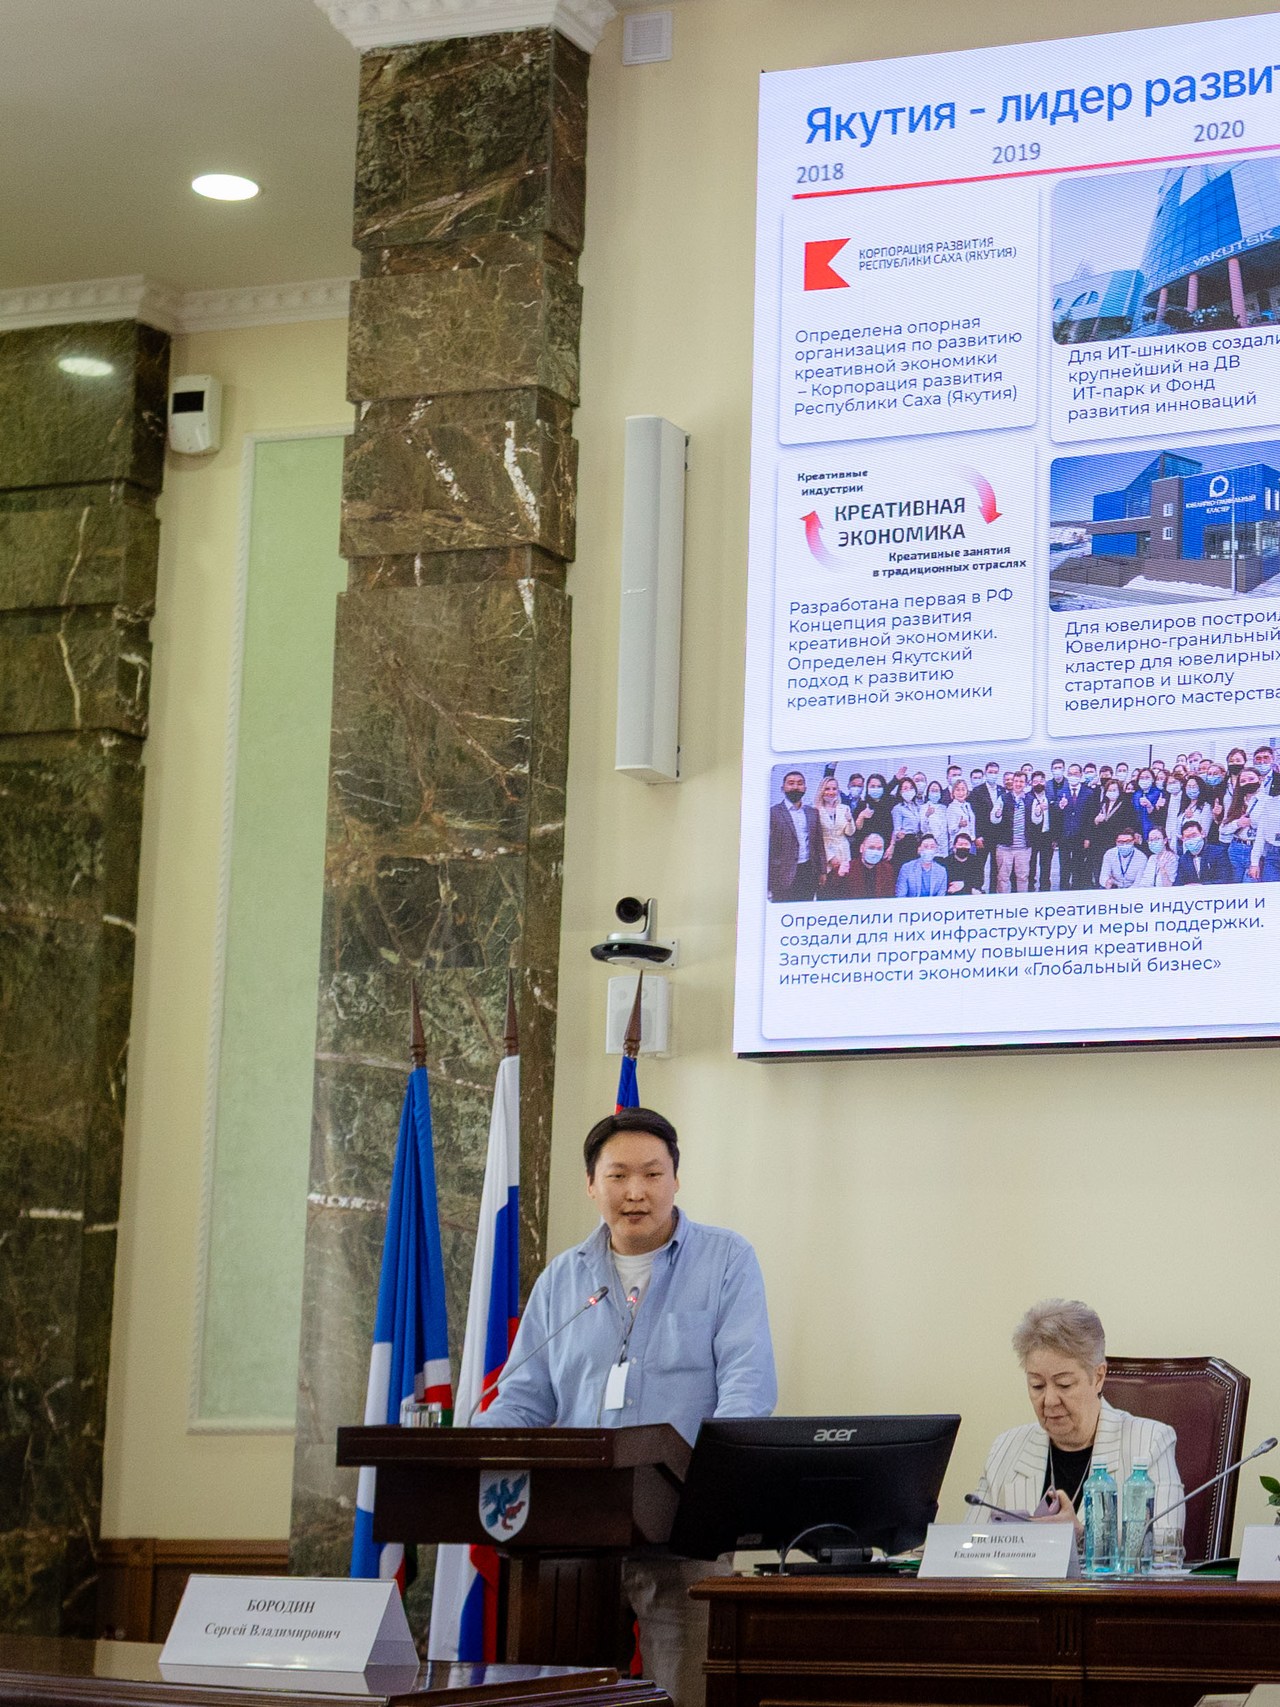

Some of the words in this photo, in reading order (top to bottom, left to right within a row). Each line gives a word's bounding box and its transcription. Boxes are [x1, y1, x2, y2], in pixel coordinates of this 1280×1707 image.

[806, 102, 956, 148] Якутия
[997, 82, 1133, 126] лидер
[1193, 118, 1246, 144] 2020
[991, 141, 1042, 165] 2019
[796, 161, 845, 186] 2018
[859, 242, 934, 259] КОРПОРАЦИЯ
[935, 237, 994, 252] РАЗВИТИЯ
[859, 255, 931, 271] РЕСПУБЛИКИ
[933, 252, 962, 265] САХА
[965, 246, 1017, 263] (ЯКУТИЯ)
[794, 323, 903, 345] Определена
[906, 316, 981, 336] опорная
[1067, 348, 1103, 367] Для
[1107, 339, 1208, 361] ИТ-шников
[1068, 359, 1183, 386] крупнейший
[1188, 359, 1210, 373] на
[1213, 353, 1241, 374] ДВ
[797, 469, 869, 484] Креативные
[801, 484, 864, 497] индустрии
[834, 496, 966, 523] КРЕАТИВНАЯ
[837, 523, 966, 549] ЭКОНОМИКА
[888, 548, 961, 564] Креативные
[962, 545, 1011, 558] занятия
[872, 568, 880, 578] в
[881, 563, 970, 580] традиционных
[971, 559, 1027, 572] отраслях
[1064, 620, 1100, 639] Для
[1105, 615, 1197, 634] ювелиров
[786, 688, 890, 712] креативной
[894, 685, 993, 703] экономики
[1064, 692, 1177, 713] ювелирного
[780, 911, 894, 930] Определили
[898, 906, 1030, 927] приоритетные
[1034, 901, 1145, 921] креативные
[1149, 896, 1249, 916] индустрии
[1254, 896, 1266, 910] и
[779, 968, 914, 986] интенсивности
[918, 964, 1019, 982] экономики
[1023, 956, 1142, 978] «Глобальный
[1146, 956, 1222, 974] бизнес»
[813, 1428, 857, 1442] acer
[246, 1599, 316, 1614] БОРОДИН
[204, 1622, 247, 1638] Сергей
[250, 1624, 341, 1642] Владимирович
